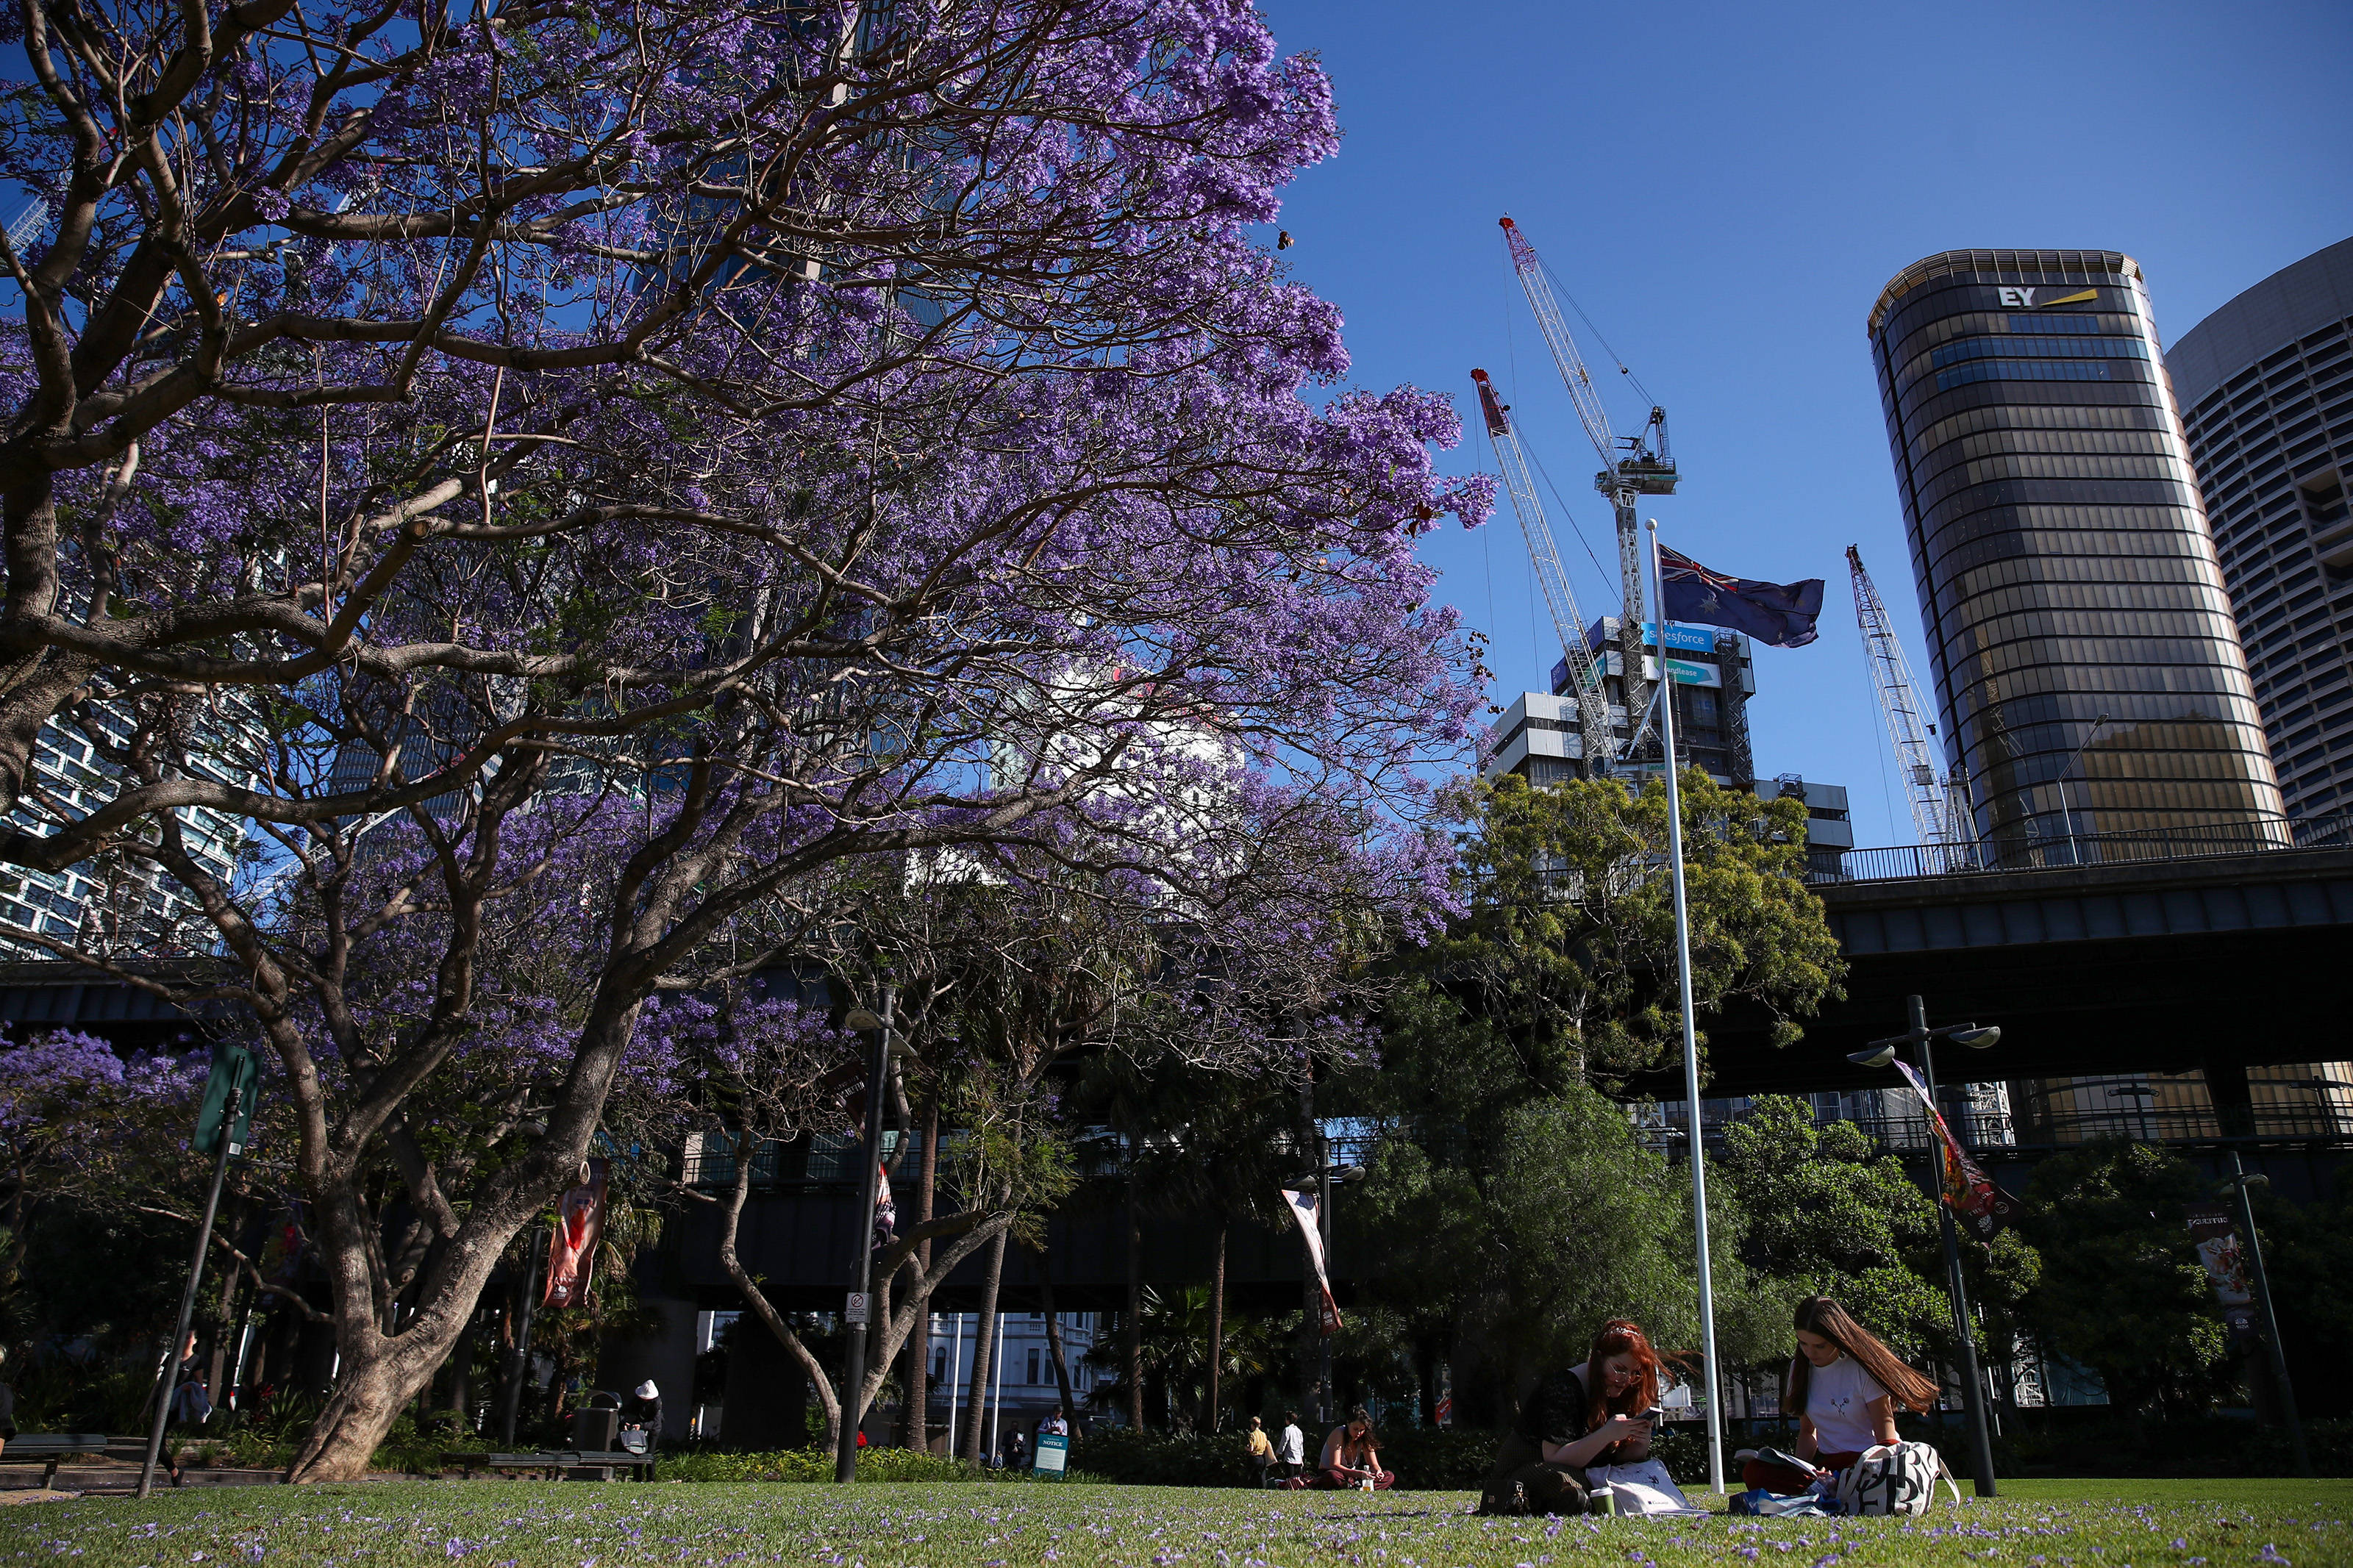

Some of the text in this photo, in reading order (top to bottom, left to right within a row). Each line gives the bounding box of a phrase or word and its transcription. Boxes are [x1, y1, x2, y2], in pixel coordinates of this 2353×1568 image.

[1998, 287, 2035, 307] EY
[1649, 630, 1704, 645] sesforce
[1666, 667, 1697, 676] endlease
